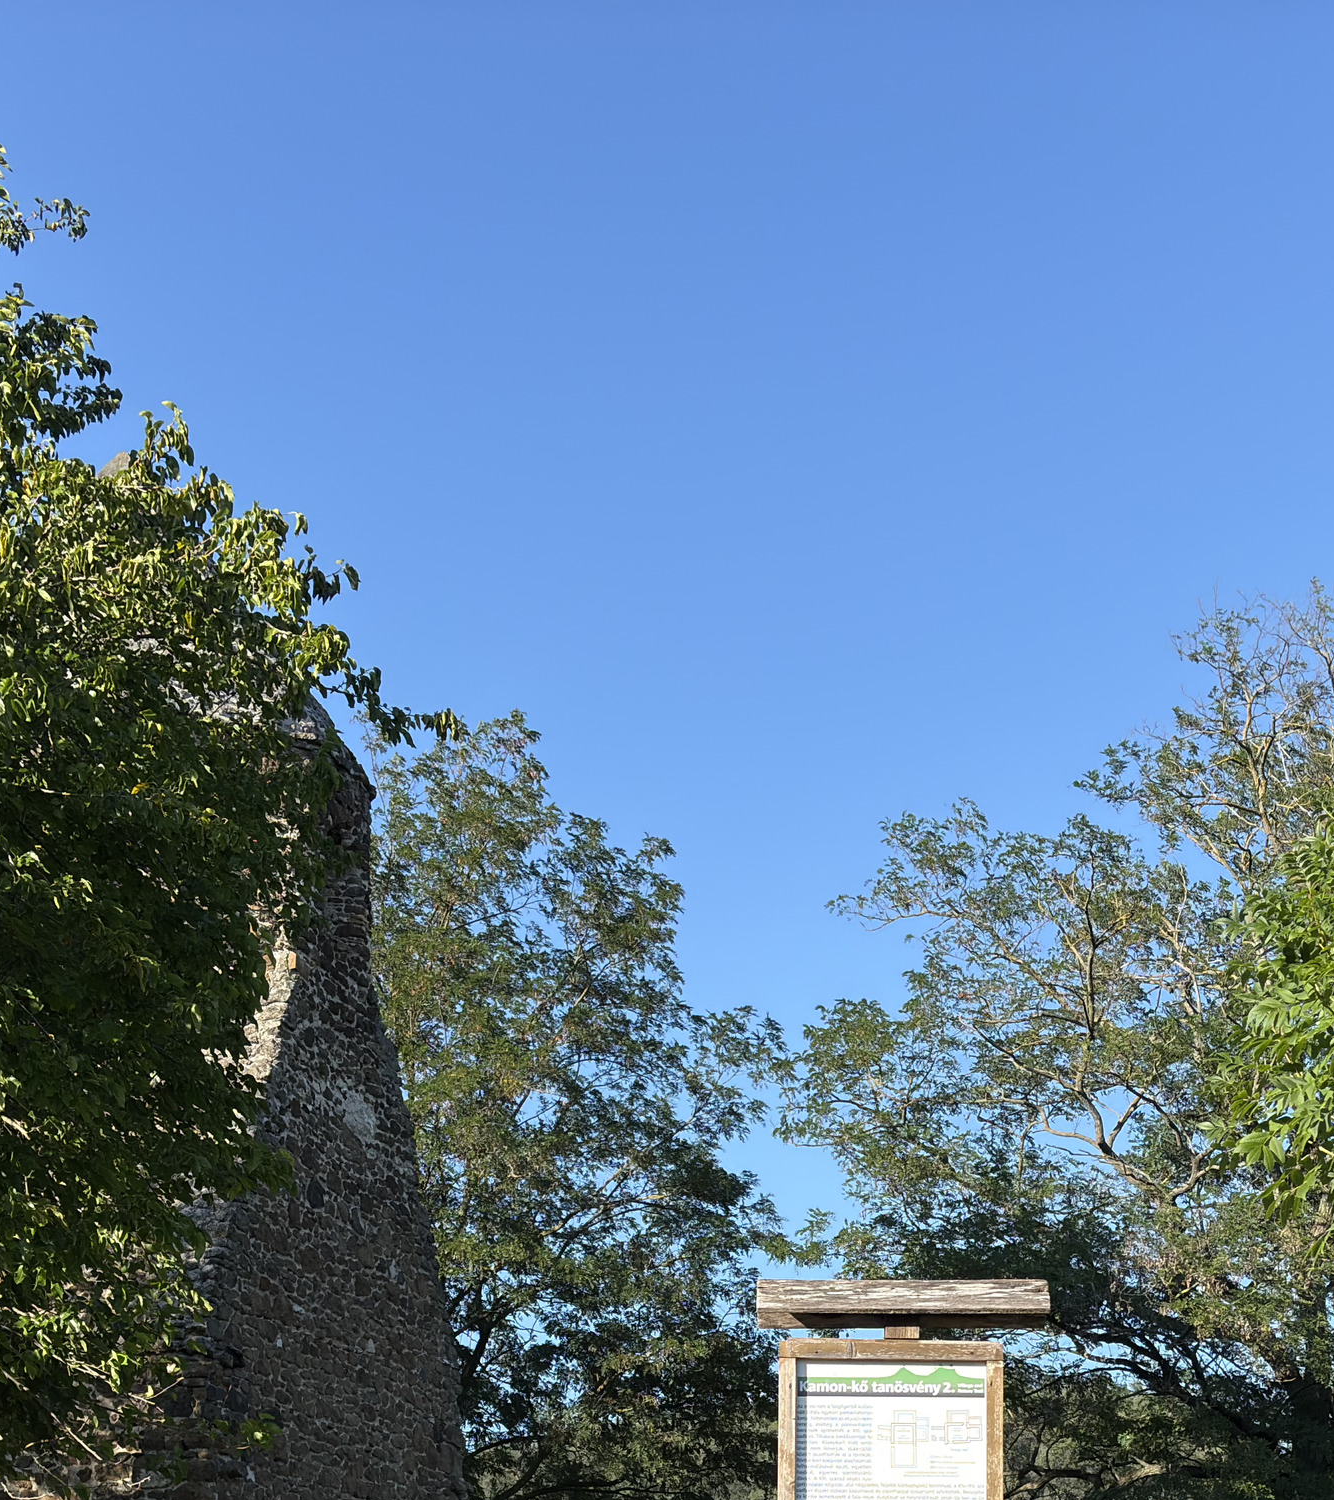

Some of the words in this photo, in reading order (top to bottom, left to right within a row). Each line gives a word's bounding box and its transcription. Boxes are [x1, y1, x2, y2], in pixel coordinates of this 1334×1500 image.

[799, 1380, 869, 1393] Kamon-kő
[872, 1380, 941, 1396] tanösvény
[942, 1382, 955, 1393] 2.
